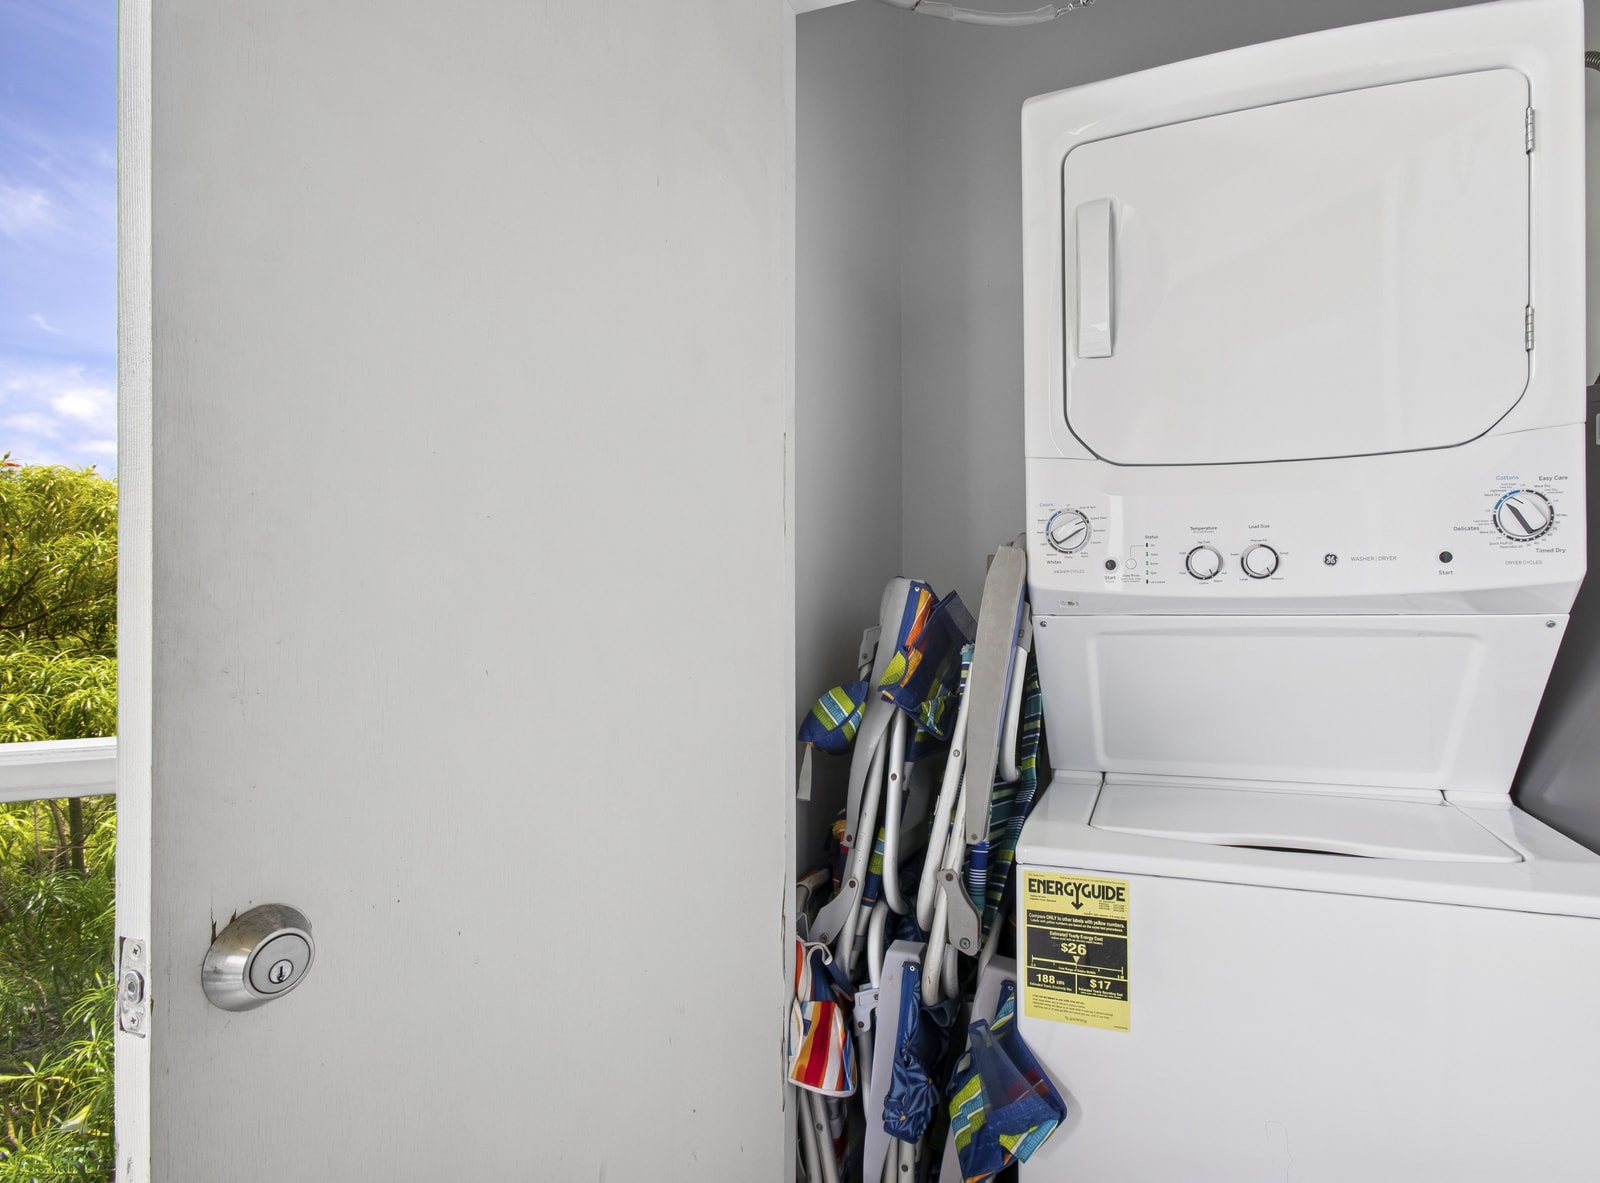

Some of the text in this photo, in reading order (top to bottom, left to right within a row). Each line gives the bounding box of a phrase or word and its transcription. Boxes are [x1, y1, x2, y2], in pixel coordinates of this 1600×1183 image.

[1028, 878, 1126, 902] ENERGYGUIDE
[1060, 942, 1087, 956] $26
[1036, 973, 1055, 984] 188
[1089, 979, 1111, 990] $17
